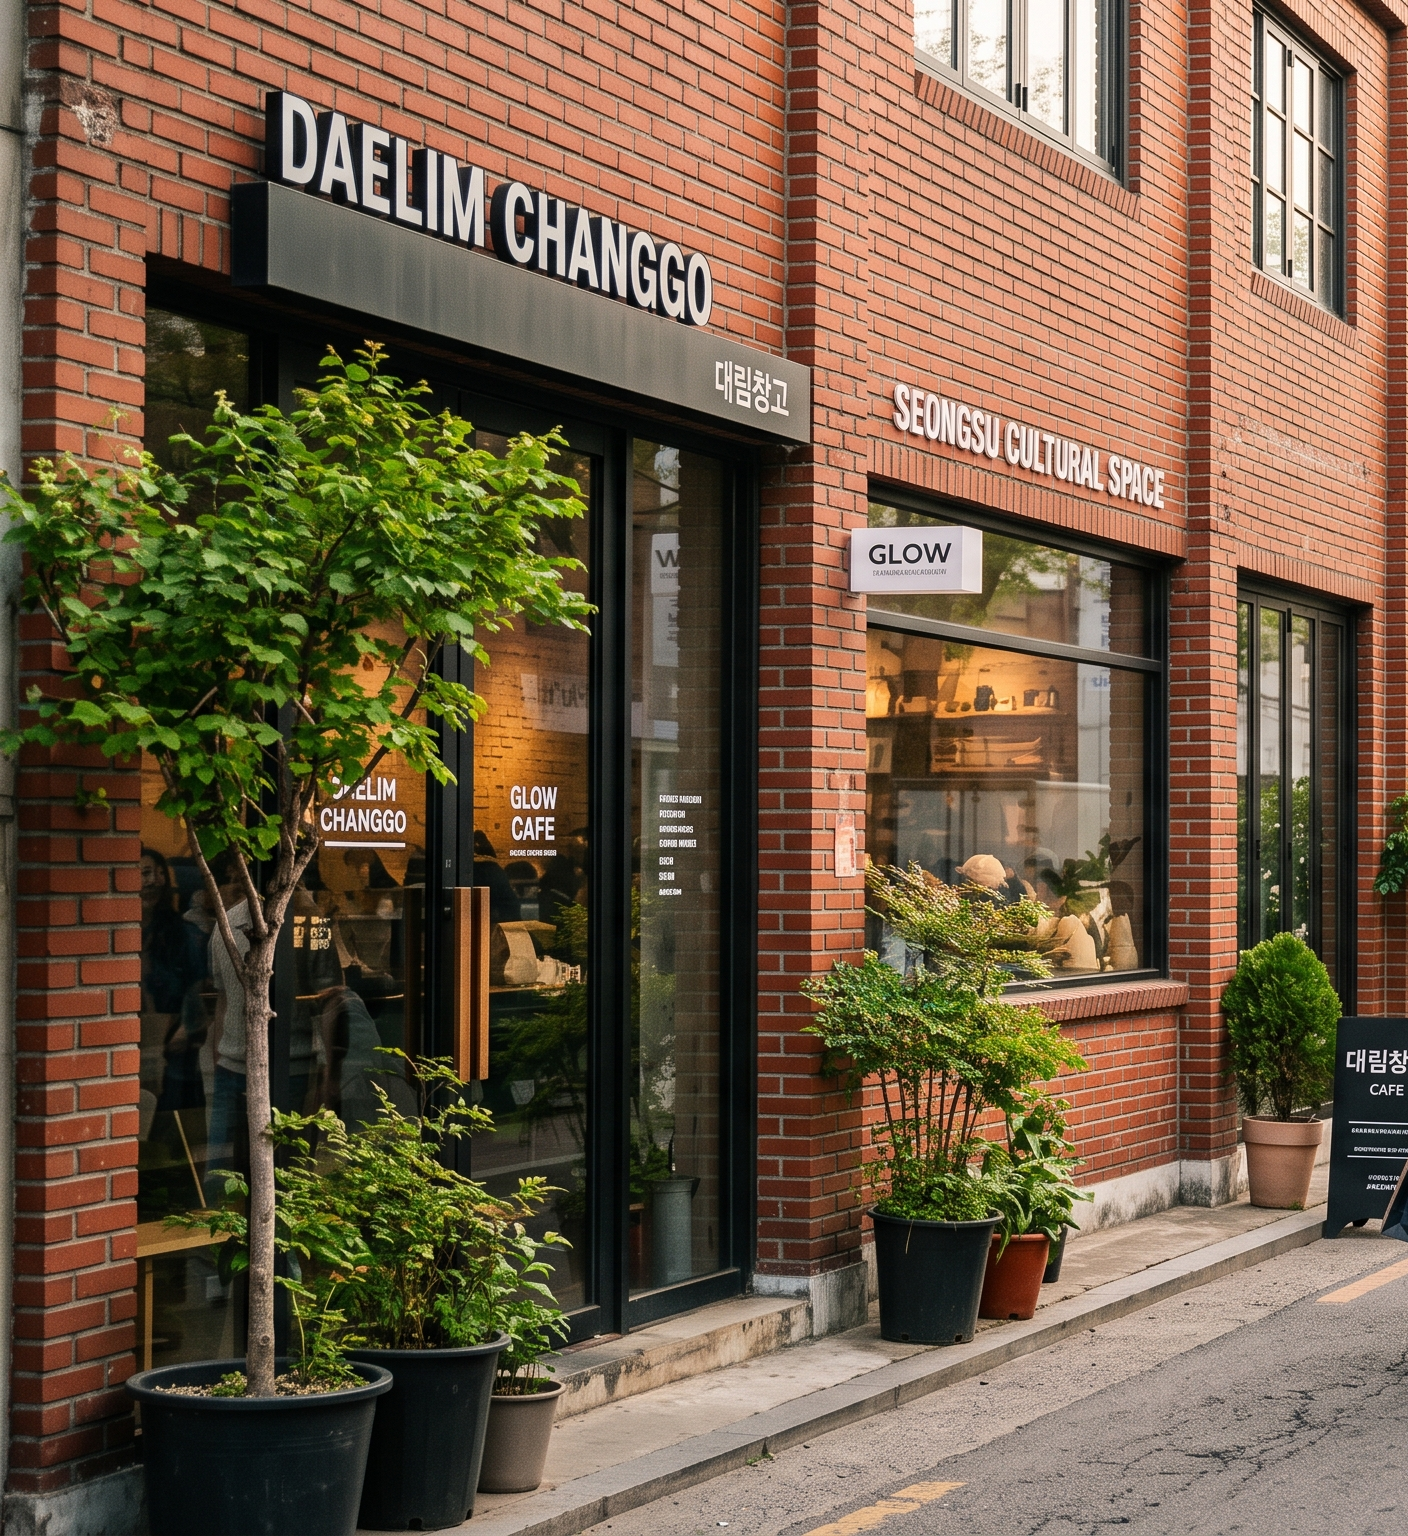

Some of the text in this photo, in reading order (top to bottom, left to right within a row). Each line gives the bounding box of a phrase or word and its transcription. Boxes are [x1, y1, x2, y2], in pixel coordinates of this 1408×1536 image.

[281, 91, 713, 327] DAELIM CHANGGO
[715, 359, 790, 417] 대림창고
[893, 383, 1165, 509] SEONGSU CULTURAL SPACE
[868, 542, 952, 565] GLOW
[510, 785, 558, 810] GLOW
[320, 807, 407, 833] CHANGGO
[511, 816, 556, 841] CAFE
[1369, 1084, 1404, 1096] CAFE
